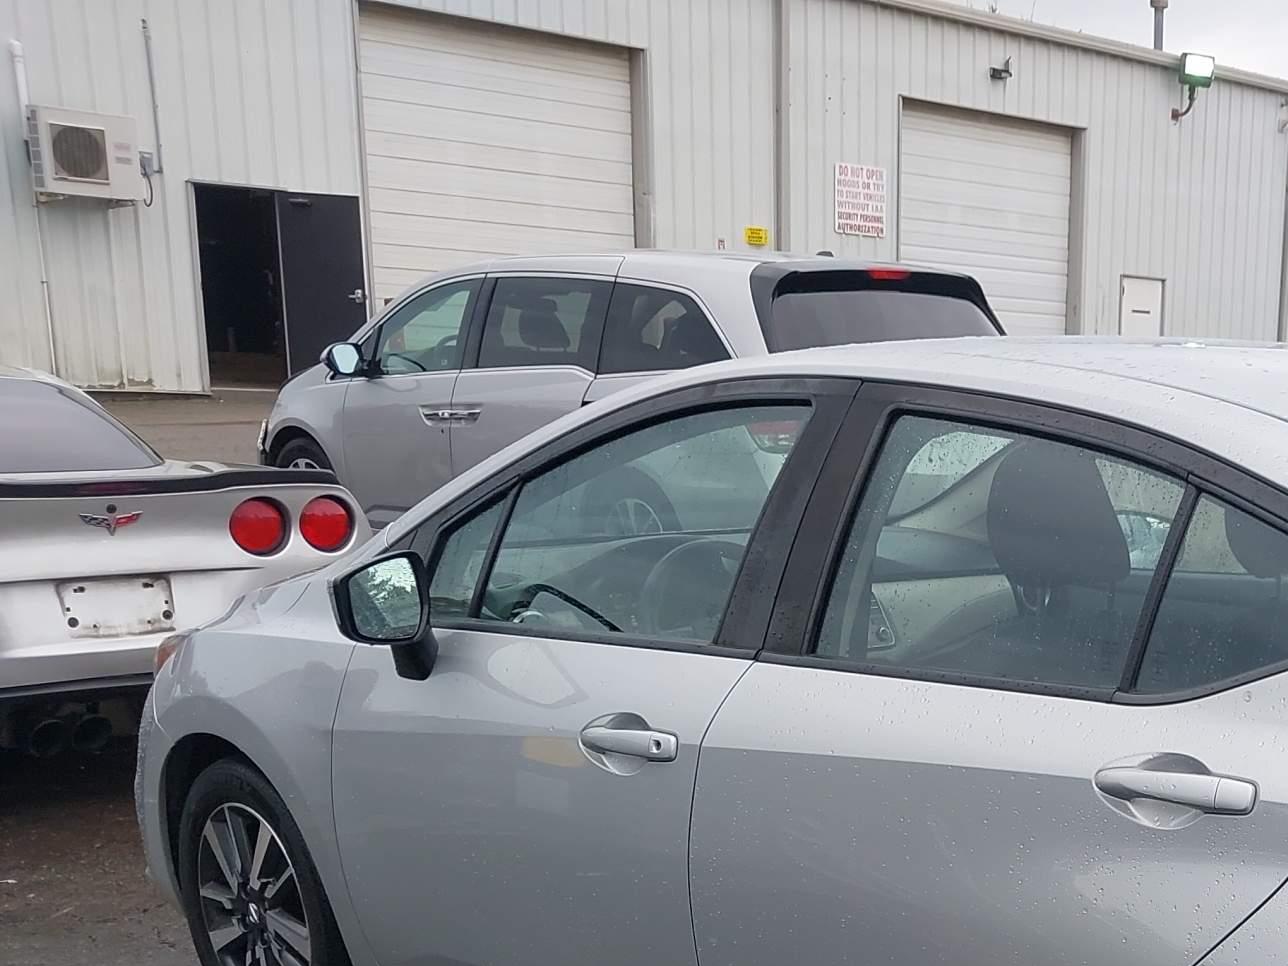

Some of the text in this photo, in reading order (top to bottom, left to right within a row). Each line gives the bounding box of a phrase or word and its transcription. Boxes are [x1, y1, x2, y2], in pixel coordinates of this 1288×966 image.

[839, 165, 884, 181] DO NOT OPEN
[837, 177, 884, 192] HOODS OR TRY
[837, 189, 885, 203] TO START VEHICLES
[837, 200, 883, 212] WITHOUT IAA
[838, 211, 884, 224] SECURITY PERSONNEL
[837, 222, 884, 234] AUTHORIZATION
